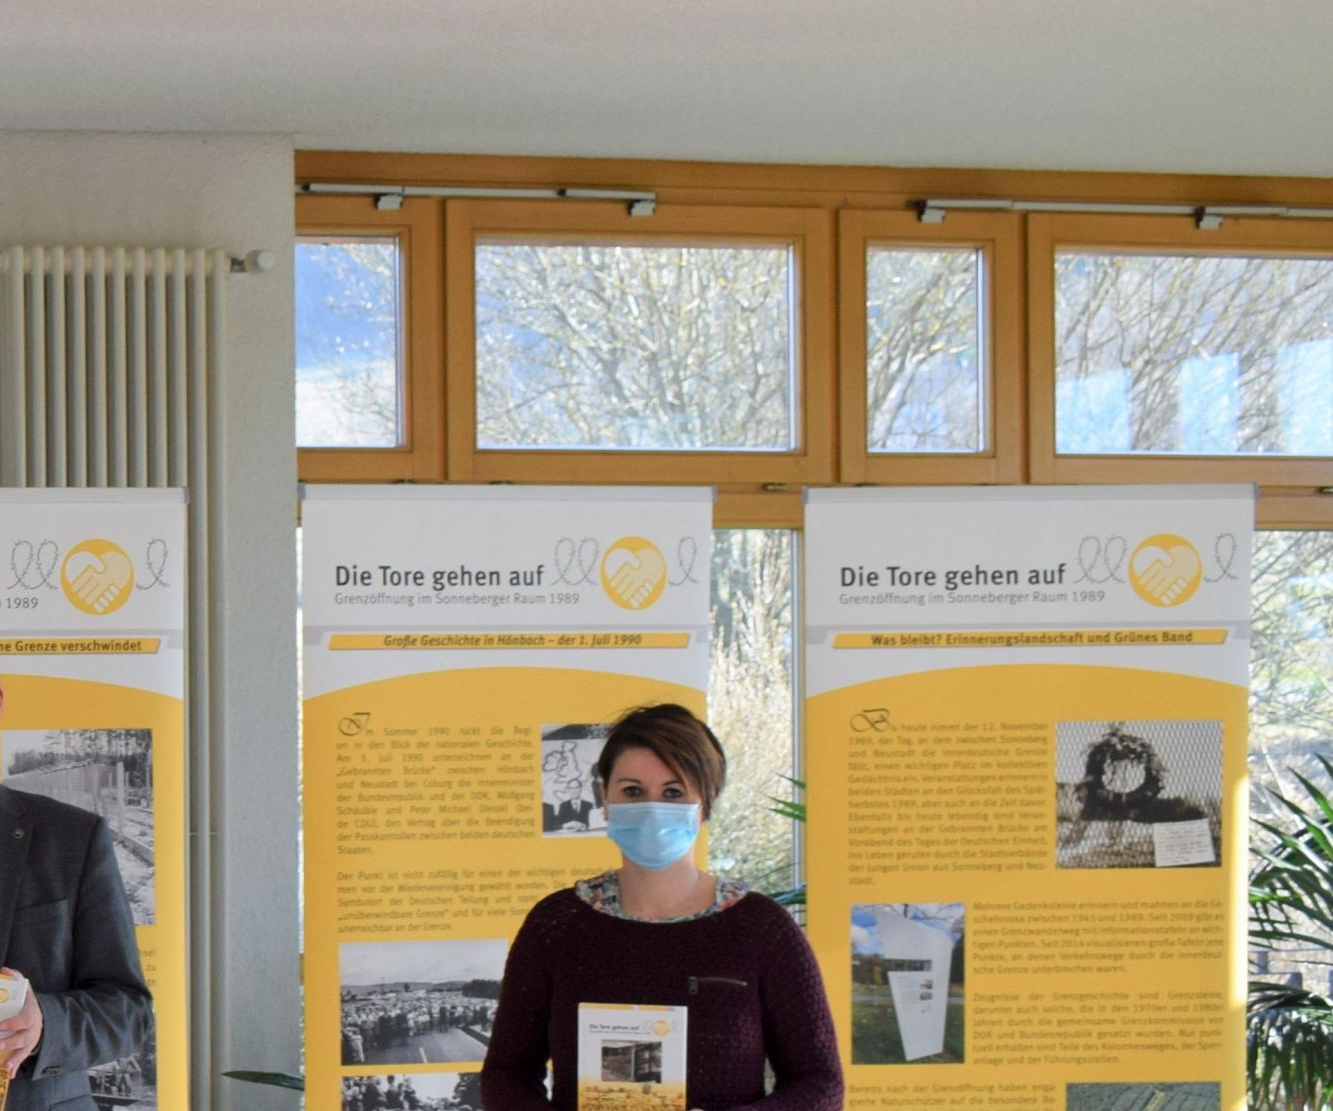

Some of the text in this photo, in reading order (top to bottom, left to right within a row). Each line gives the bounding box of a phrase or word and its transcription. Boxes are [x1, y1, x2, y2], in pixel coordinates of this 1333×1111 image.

[335, 563, 545, 592] Die Tore gehen auf
[839, 562, 1067, 592] Die Tore gehen auf
[5, 595, 39, 610] 1989
[333, 590, 581, 608] Grenzöffnung im Sonneberger Raum 1989
[838, 589, 1106, 607] Grenzöffnung im Sonneberger Raum 1989
[13, 639, 59, 653] Grenze
[59, 639, 142, 652] verschwindet
[382, 633, 419, 650] Große
[419, 633, 482, 647] Geschichte
[482, 633, 495, 646] in
[496, 633, 546, 649] Hönbach
[555, 633, 577, 649] der
[578, 633, 589, 646] 1.
[588, 633, 611, 649] Juli
[613, 633, 643, 649] 1990
[870, 630, 1194, 647] Was bleibt? Erinnerungslandschaft und Grünes Band
